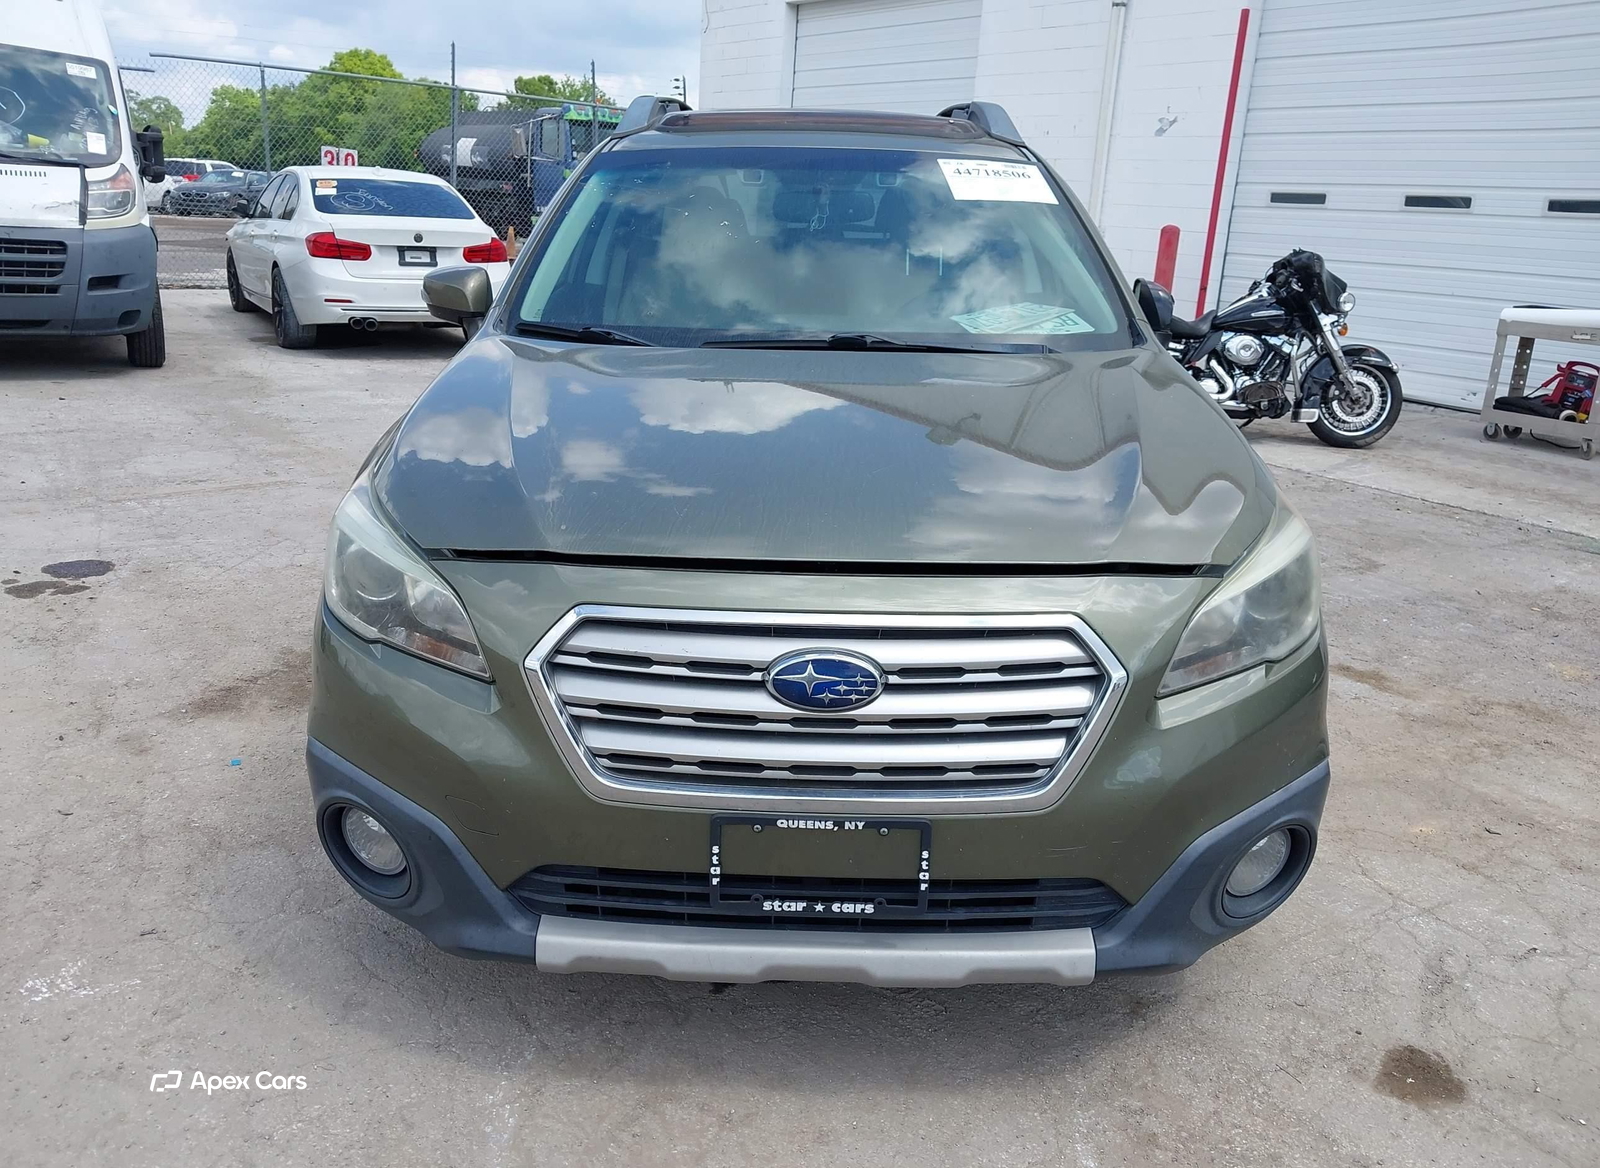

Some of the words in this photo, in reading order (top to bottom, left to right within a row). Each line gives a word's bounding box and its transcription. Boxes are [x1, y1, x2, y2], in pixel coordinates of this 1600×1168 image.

[953, 168, 1031, 179] 44718506
[776, 819, 840, 831] QUEENS,
[844, 821, 866, 831] NY
[710, 845, 721, 885] star
[918, 850, 930, 891] star
[762, 900, 807, 912] star
[831, 901, 875, 914] cars
